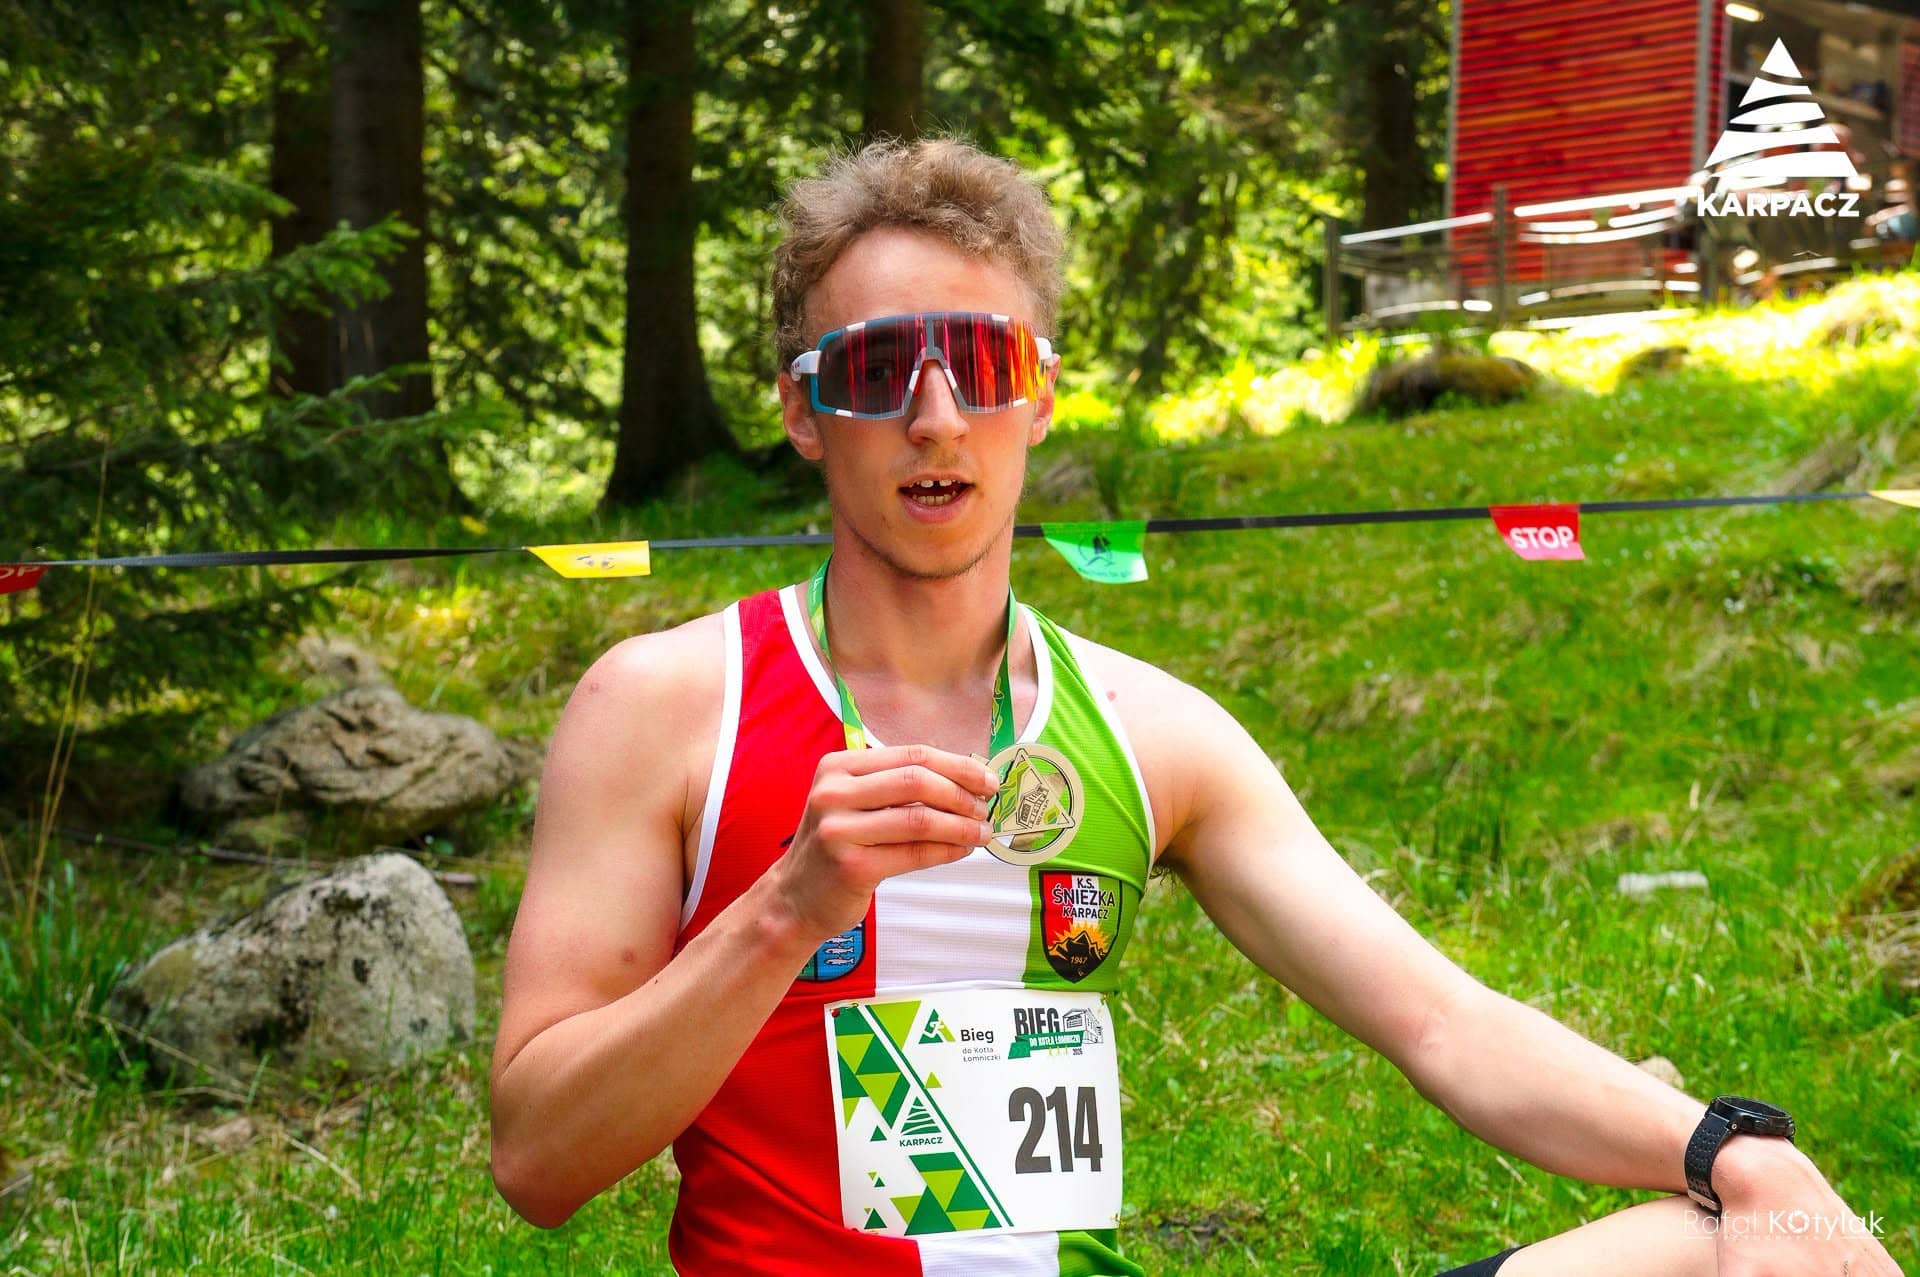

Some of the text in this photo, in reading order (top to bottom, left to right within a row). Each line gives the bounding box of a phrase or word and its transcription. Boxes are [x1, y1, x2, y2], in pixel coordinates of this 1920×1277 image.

[1509, 525, 1575, 550] STOP
[1077, 877, 1095, 889] K.S.
[1063, 907, 1109, 920] KARPACZ
[1013, 1007, 1061, 1035] BIEG
[960, 1028, 994, 1043] Bieg
[1008, 1086, 1103, 1175] 214
[899, 1137, 944, 1147] KARPACZ
